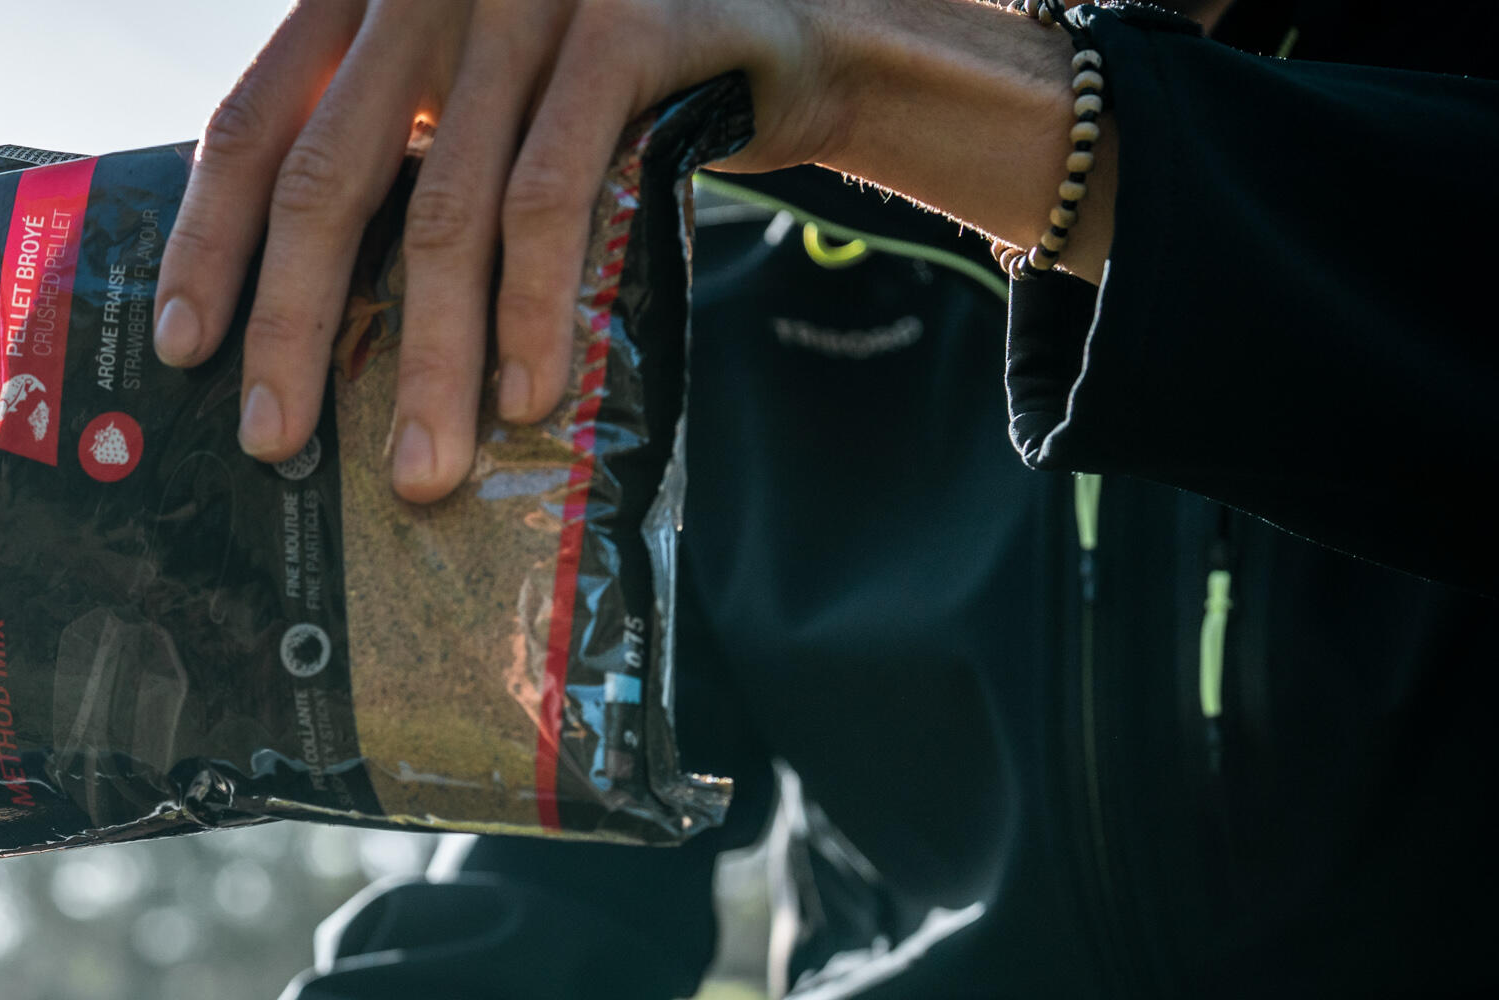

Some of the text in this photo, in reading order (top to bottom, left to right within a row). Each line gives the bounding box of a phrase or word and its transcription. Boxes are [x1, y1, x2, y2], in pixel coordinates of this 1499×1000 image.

[5, 214, 45, 358] PELLET BROYÉ
[32, 207, 72, 356] CRUSHED PELLET
[94, 263, 127, 392] ARÔME FRAISE
[122, 207, 160, 391] STRAWBERRY FLAVOUR
[284, 565, 301, 598] FINE
[302, 488, 322, 610] FINE PARTICLES
